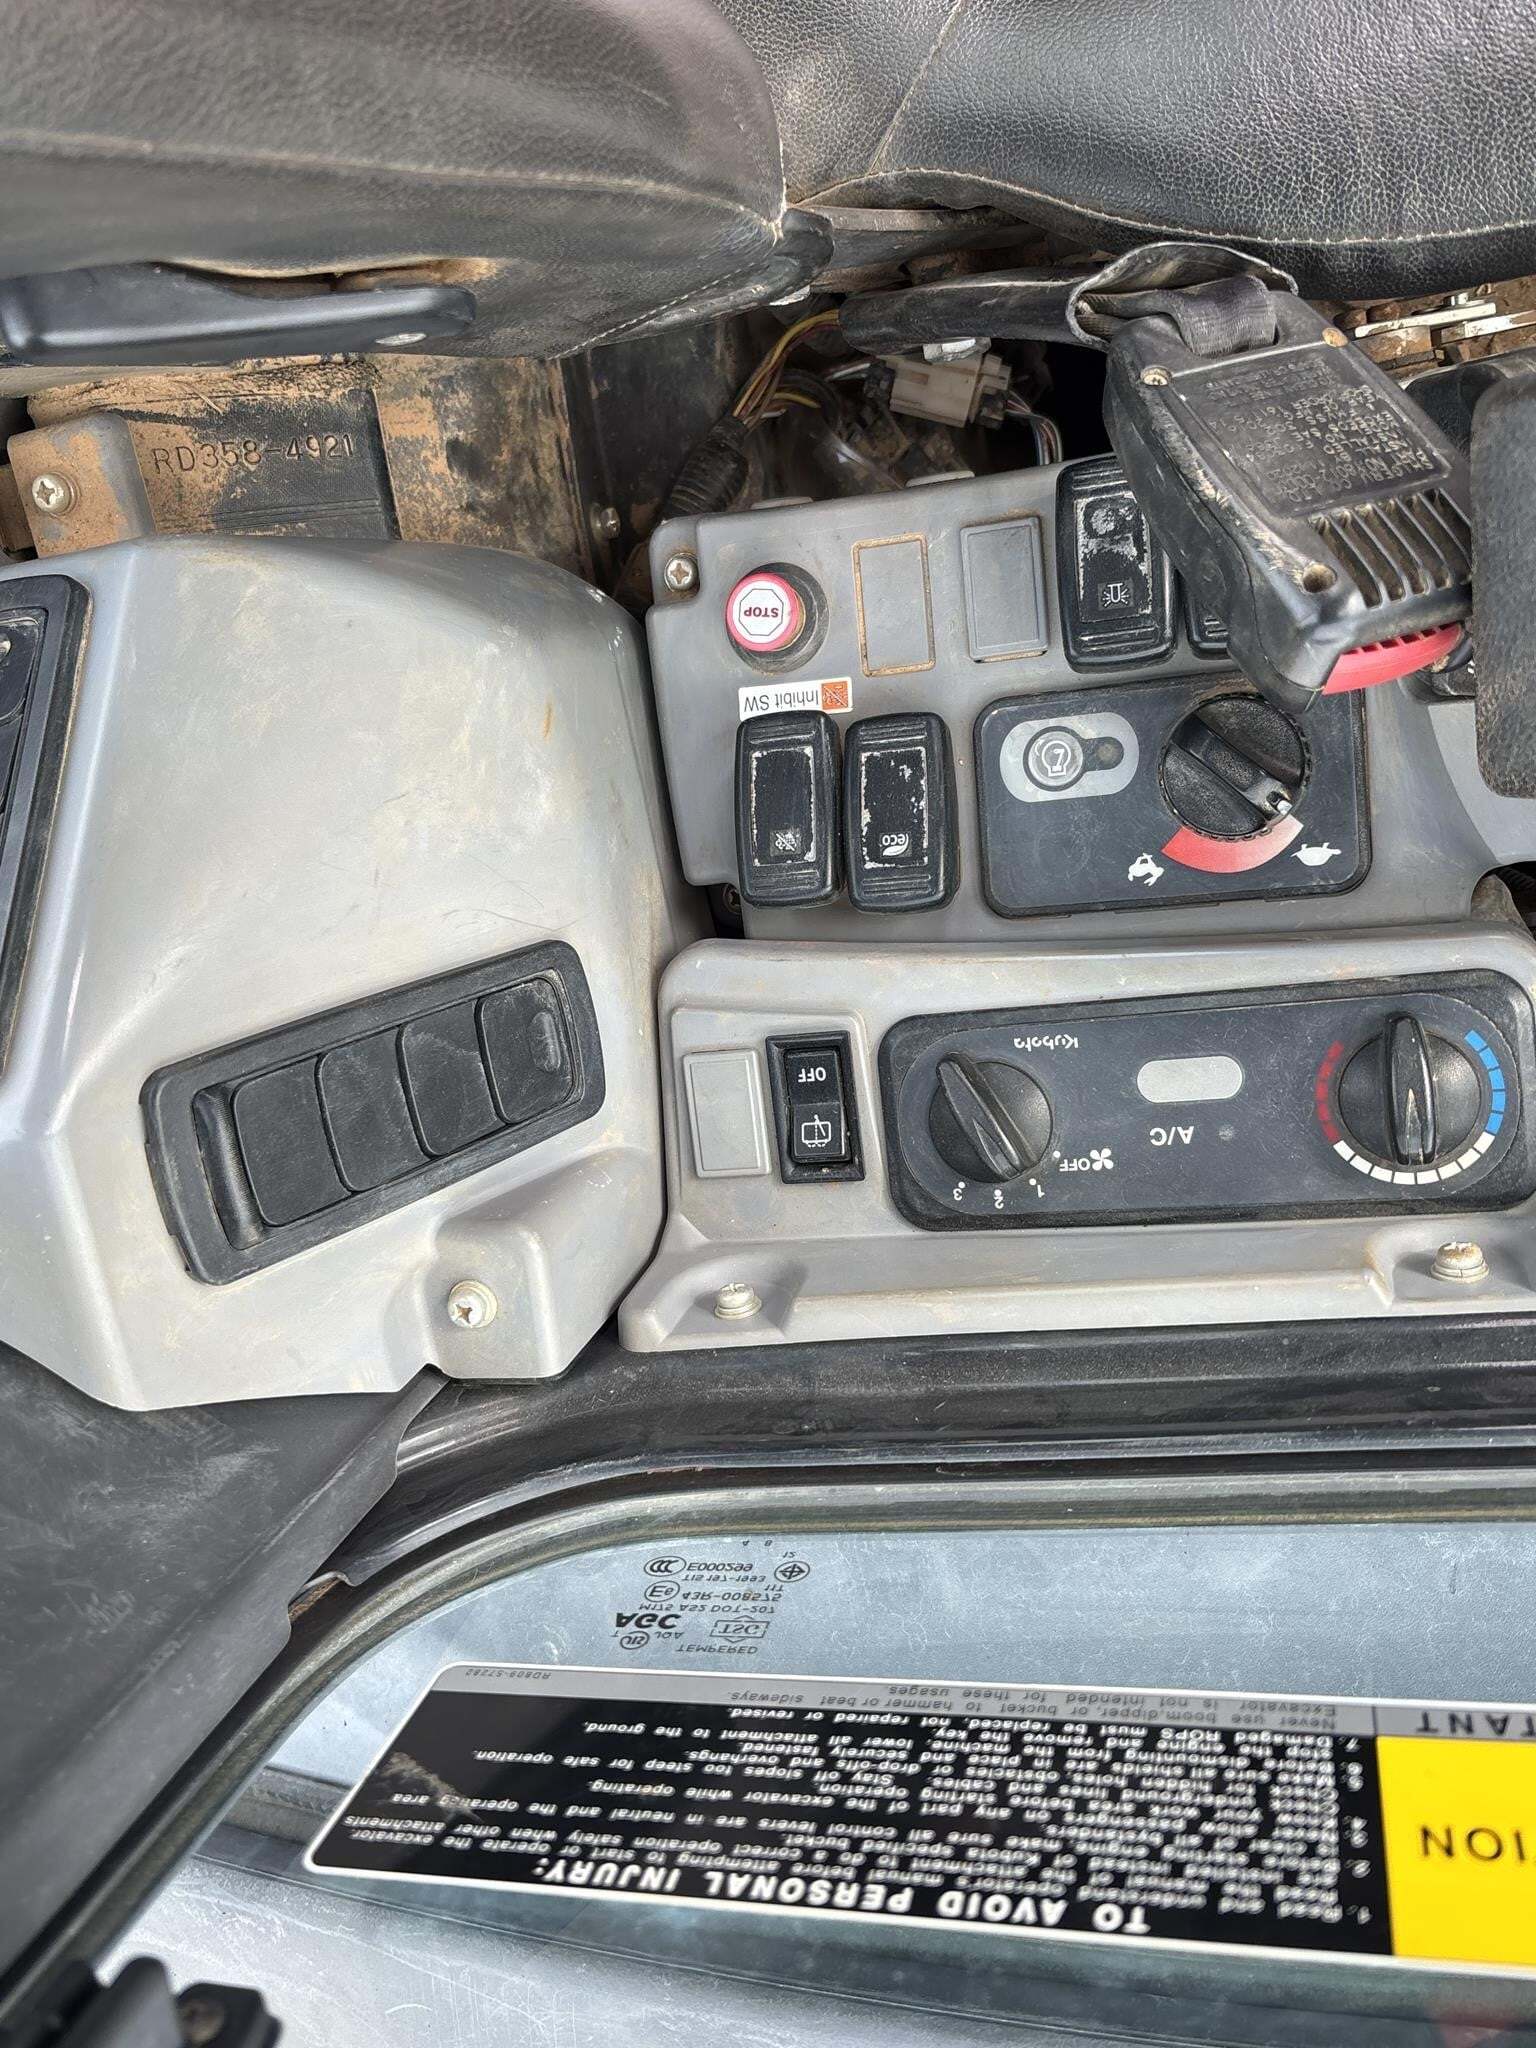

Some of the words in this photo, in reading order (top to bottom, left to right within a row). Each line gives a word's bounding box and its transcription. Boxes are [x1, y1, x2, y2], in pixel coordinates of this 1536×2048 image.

[151, 433, 354, 474] RD358-4921
[743, 606, 779, 618] STOP
[744, 695, 770, 712] SW
[775, 690, 819, 708] Inhibit
[881, 834, 906, 846] eco
[1013, 1034, 1079, 1052] Kubota
[798, 1066, 827, 1083] OFF
[1150, 1125, 1194, 1147] A/C
[1059, 1157, 1091, 1172] OFF
[952, 1187, 963, 1201] 3
[1037, 1184, 1046, 1199] 1
[993, 1195, 1004, 1209] 2
[727, 1689, 803, 1703] sideways.
[887, 1682, 950, 1697] usages.
[961, 1688, 1010, 1701] these
[1021, 1690, 1047, 1703] for
[820, 1695, 856, 1706] beat
[861, 1696, 879, 1706] or
[1065, 1692, 1145, 1707] intended
[1158, 1696, 1188, 1708] not
[1201, 1698, 1217, 1710] is
[1238, 1699, 1336, 1715] Excavator
[727, 1706, 794, 1719] revised.
[803, 1710, 823, 1719] or
[832, 1709, 909, 1724] repaired
[582, 1720, 645, 1734] ground,
[919, 1715, 951, 1726] not
[962, 1715, 1051, 1732] replaced,
[1062, 1722, 1088, 1734] be
[654, 1725, 682, 1737] the
[692, 1726, 710, 1738] to
[720, 1728, 818, 1743] attachment
[930, 1725, 969, 1739] key.
[979, 1729, 1012, 1741] the
[1099, 1724, 1147, 1736] must
[1159, 1726, 1220, 1740] ROPS
[1233, 1727, 1332, 1746] Damaged
[827, 1733, 851, 1745] all
[859, 1735, 913, 1748] lower
[926, 1738, 1012, 1753] machine,
[1022, 1731, 1094, 1745] remove
[1104, 1736, 1144, 1748] and
[1155, 1735, 1226, 1752] engine
[738, 1740, 820, 1756] fastened.
[829, 1743, 908, 1760] securely
[1021, 1743, 1055, 1757] the
[1065, 1745, 1112, 1760] from
[1237, 1742, 1274, 1756] the
[472, 1748, 553, 1764] operation.
[562, 1754, 600, 1768] safe
[609, 1757, 633, 1770] for
[684, 1747, 778, 1765] overhangs.
[788, 1755, 825, 1768] and
[919, 1750, 955, 1763] and
[967, 1752, 1022, 1768] place
[1031, 1756, 1053, 1770] in
[1124, 1747, 1250, 1768] dismounting
[644, 1757, 693, 1773] steep
[704, 1762, 733, 1775] too
[743, 1763, 803, 1779] slopes
[835, 1757, 921, 1773] drop-offs
[930, 1763, 954, 1774] or
[1063, 1758, 1099, 1773] are
[1109, 1760, 1184, 1779] shields
[1191, 1765, 1217, 1780] all
[811, 1769, 840, 1782] off
[849, 1768, 894, 1785] Stay
[586, 1777, 675, 1797] operating.
[813, 1779, 909, 1799] operation.
[926, 1776, 997, 1792] cables.
[1005, 1780, 1046, 1795] and
[1138, 1775, 1213, 1792] hidden
[390, 1791, 430, 1805] area
[685, 1786, 733, 1802] while
[742, 1789, 835, 1808] excavator
[919, 1785, 998, 1805] starting
[1056, 1784, 1109, 1800] lines
[1118, 1785, 1255, 1809] underground
[439, 1793, 518, 1812] operating
[526, 1801, 557, 1814] the
[843, 1796, 877, 1811] the
[885, 1798, 910, 1815] of
[919, 1799, 964, 1816] part
[1008, 1793, 1074, 1810] before
[1087, 1798, 1136, 1814] area
[563, 1803, 601, 1818] and
[609, 1807, 675, 1823] neutral
[971, 1803, 1012, 1820] any
[1022, 1808, 1051, 1823] on
[1147, 1802, 1200, 1818] work
[342, 1814, 445, 1832] attachments
[684, 1812, 704, 1825] in
[714, 1814, 747, 1827] are
[757, 1816, 817, 1833] levers
[1062, 1809, 1186, 1832] passengers
[453, 1821, 501, 1836] other
[509, 1826, 557, 1840] when
[827, 1822, 898, 1839] control
[906, 1827, 935, 1841] all
[350, 1828, 434, 1845] excavator.
[443, 1835, 473, 1848] the
[631, 1833, 722, 1852] operation
[779, 1832, 849, 1849] bucket.
[946, 1829, 994, 1846] sure
[481, 1837, 551, 1854] operate
[560, 1843, 580, 1855] or
[591, 1846, 635, 1860] start
[730, 1842, 803, 1859] correct
[860, 1837, 954, 1857] specified
[645, 1850, 667, 1863] to
[813, 1848, 829, 1859] a
[837, 1850, 865, 1864] do
[878, 1853, 899, 1867] to
[965, 1845, 1041, 1866] Kubota
[1049, 1852, 1076, 1868] of
[675, 1851, 781, 1872] attempting
[911, 1856, 1029, 1879] attachment
[531, 1856, 681, 1892] INJURY:
[791, 1861, 857, 1879] before
[866, 1867, 944, 1885] manual
[1039, 1865, 1076, 1883] the
[955, 1873, 1067, 1898] operator's
[1087, 1869, 1114, 1887] of
[702, 1870, 915, 1912] PERSONAL
[935, 1888, 1068, 1926] AVOID
[1089, 1901, 1150, 1933] TO
